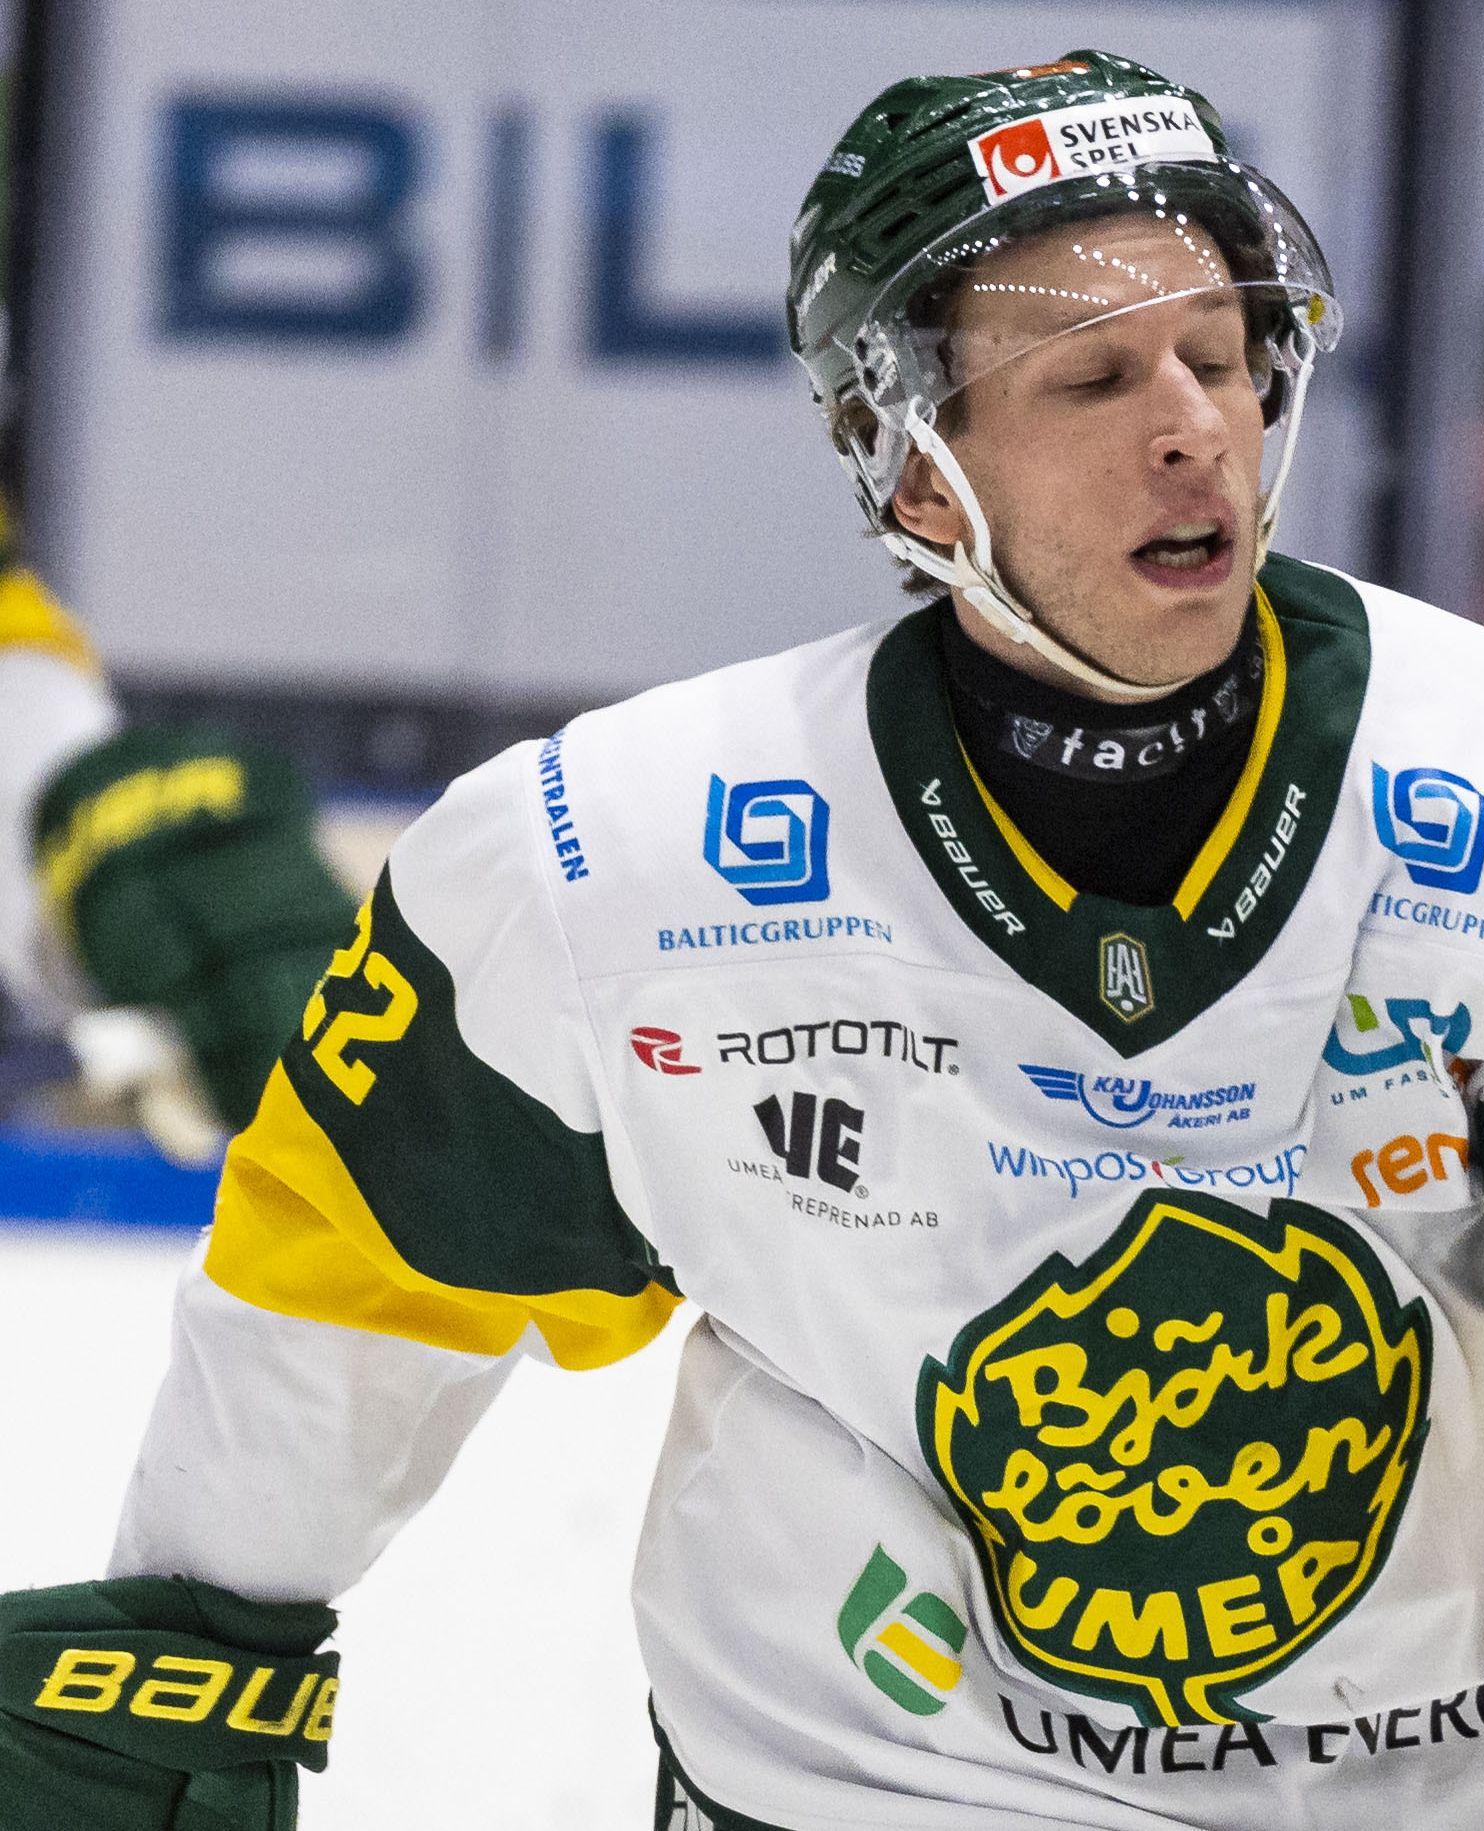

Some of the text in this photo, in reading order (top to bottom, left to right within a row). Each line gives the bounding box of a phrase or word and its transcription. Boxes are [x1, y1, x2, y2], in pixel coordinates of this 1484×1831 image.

[1060, 111, 1202, 148] SVENSKA
[658, 916, 893, 950] BALTICGRUPPEN
[1227, 1108, 1251, 1123] AB
[910, 1211, 938, 1227] AB
[1006, 1516, 1360, 1662] UMEÅ
